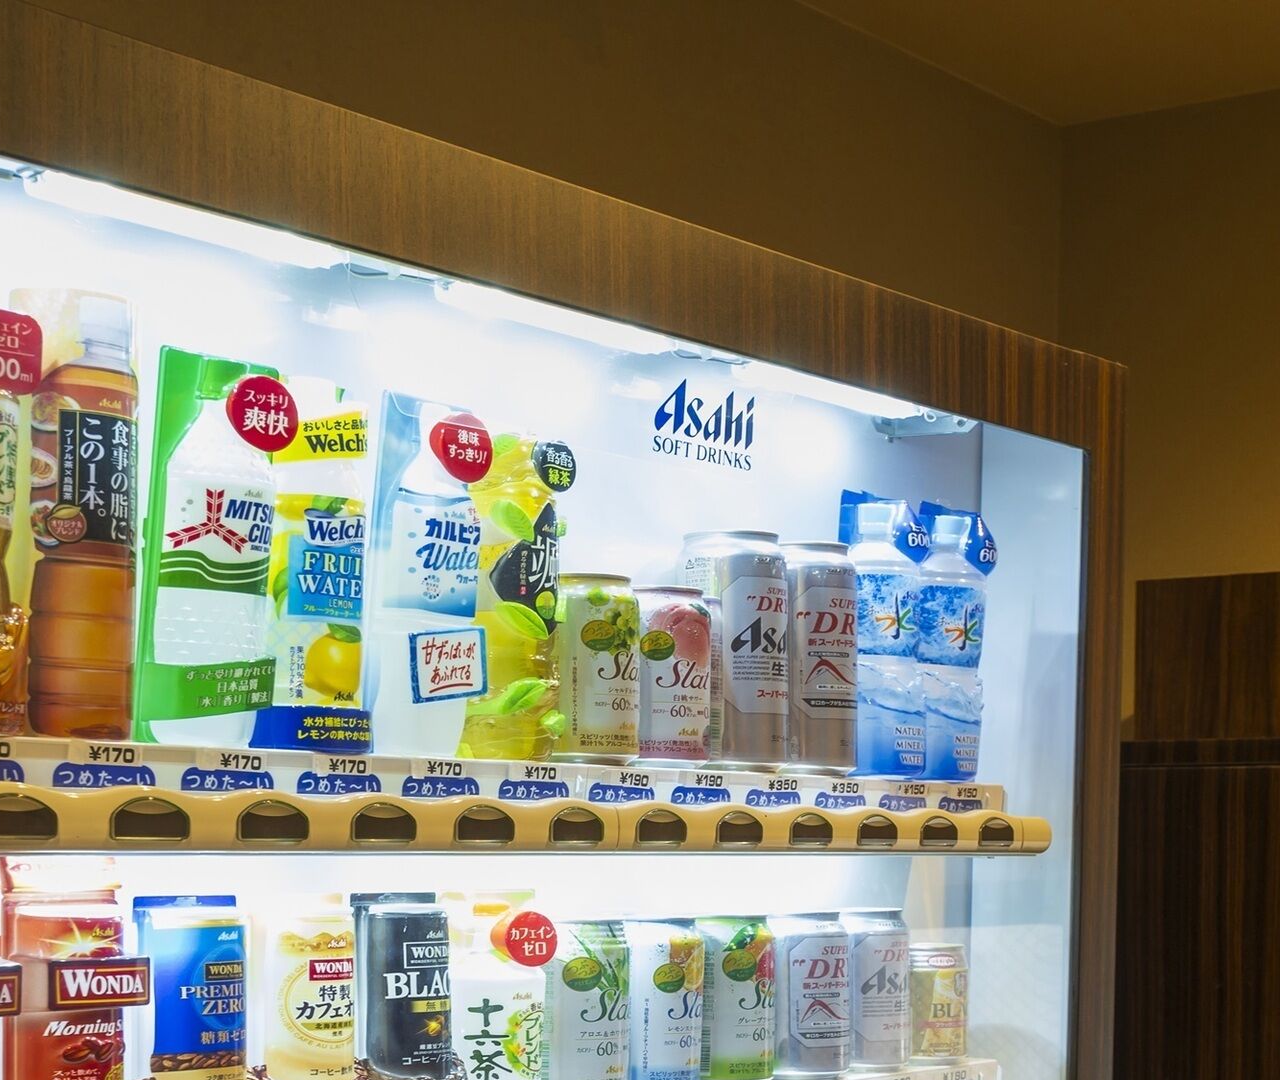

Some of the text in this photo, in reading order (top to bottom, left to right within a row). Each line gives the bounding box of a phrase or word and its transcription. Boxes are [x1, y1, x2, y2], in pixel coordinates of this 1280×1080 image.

[243, 388, 289, 408] スッキリ
[653, 378, 755, 451] Asahi
[242, 409, 289, 438] 爽快
[457, 429, 481, 447] 後味
[545, 446, 574, 468] 香る香る
[651, 435, 752, 471] SOFT DRINKS
[79, 416, 106, 518] この1本。
[110, 419, 130, 541] 食事の脂に
[547, 468, 571, 487] 緑茶
[328, 599, 354, 610] LEMON
[431, 661, 473, 685] あふれてる
[772, 662, 785, 677] 生
[217, 679, 258, 693] 日本品質
[88, 746, 136, 764] ¥170
[220, 753, 262, 771] ¥170
[328, 757, 367, 774] ¥170
[427, 761, 462, 777] ¥170
[524, 766, 557, 780] ¥170
[619, 772, 650, 787] ¥190
[695, 774, 723, 787] ¥190
[768, 779, 797, 791] ¥350
[832, 782, 859, 794] ¥350
[904, 785, 925, 795] ¥150
[957, 788, 977, 798] ¥150
[510, 926, 556, 941] カフェイン
[522, 942, 547, 956] ゼロ
[209, 965, 243, 975] WONDA
[314, 961, 352, 974] WONDA
[60, 968, 144, 998] WONDA
[318, 984, 351, 1002] 特製
[43, 1019, 115, 1037] Morning
